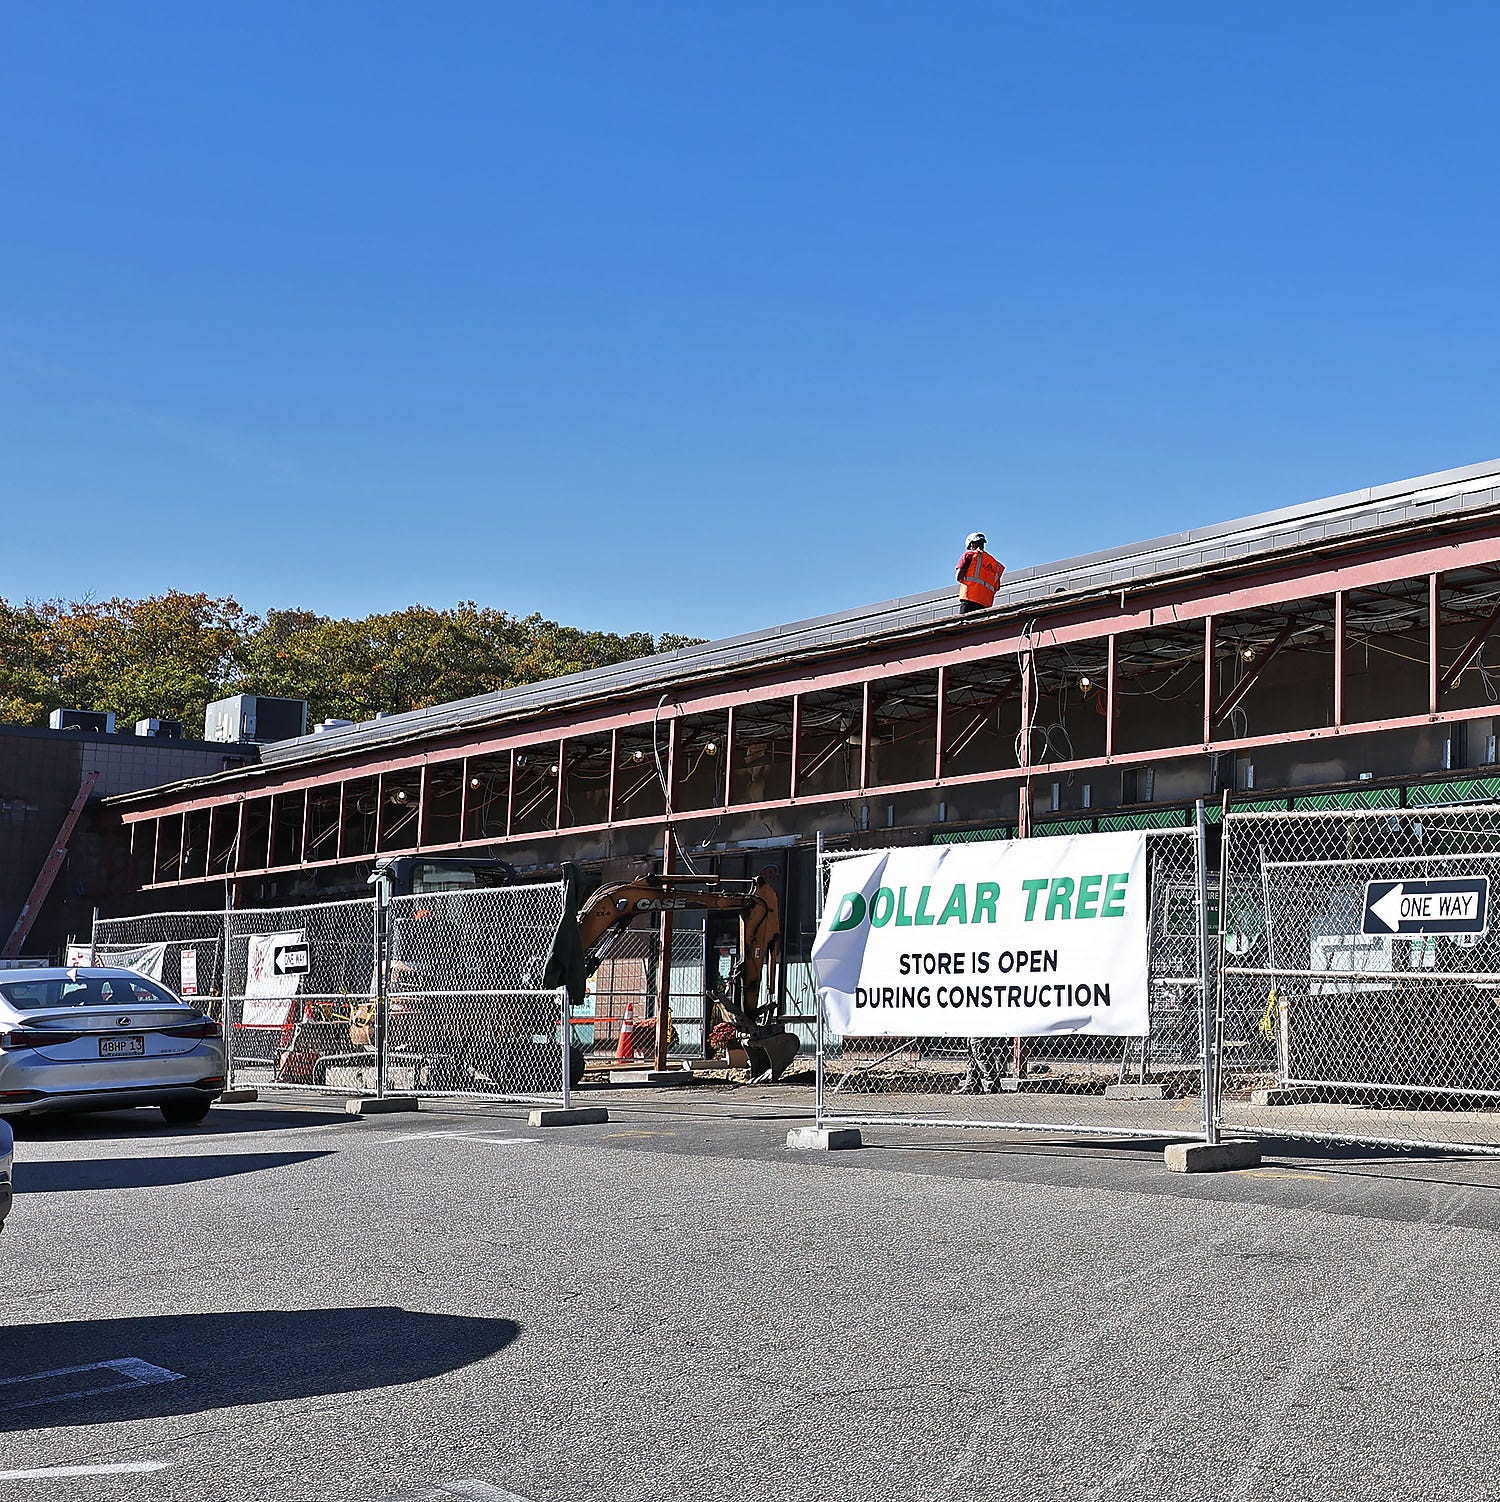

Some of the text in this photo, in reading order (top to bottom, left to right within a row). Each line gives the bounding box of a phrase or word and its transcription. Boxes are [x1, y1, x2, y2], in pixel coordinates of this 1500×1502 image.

[635, 897, 689, 911] CASE
[828, 872, 1130, 932] DOLLAR TREE
[1400, 895, 1473, 918] ONE WAY
[898, 949, 1058, 976] STORE IS OPEN
[855, 983, 1111, 1009] DURING CONSTRUCTION
